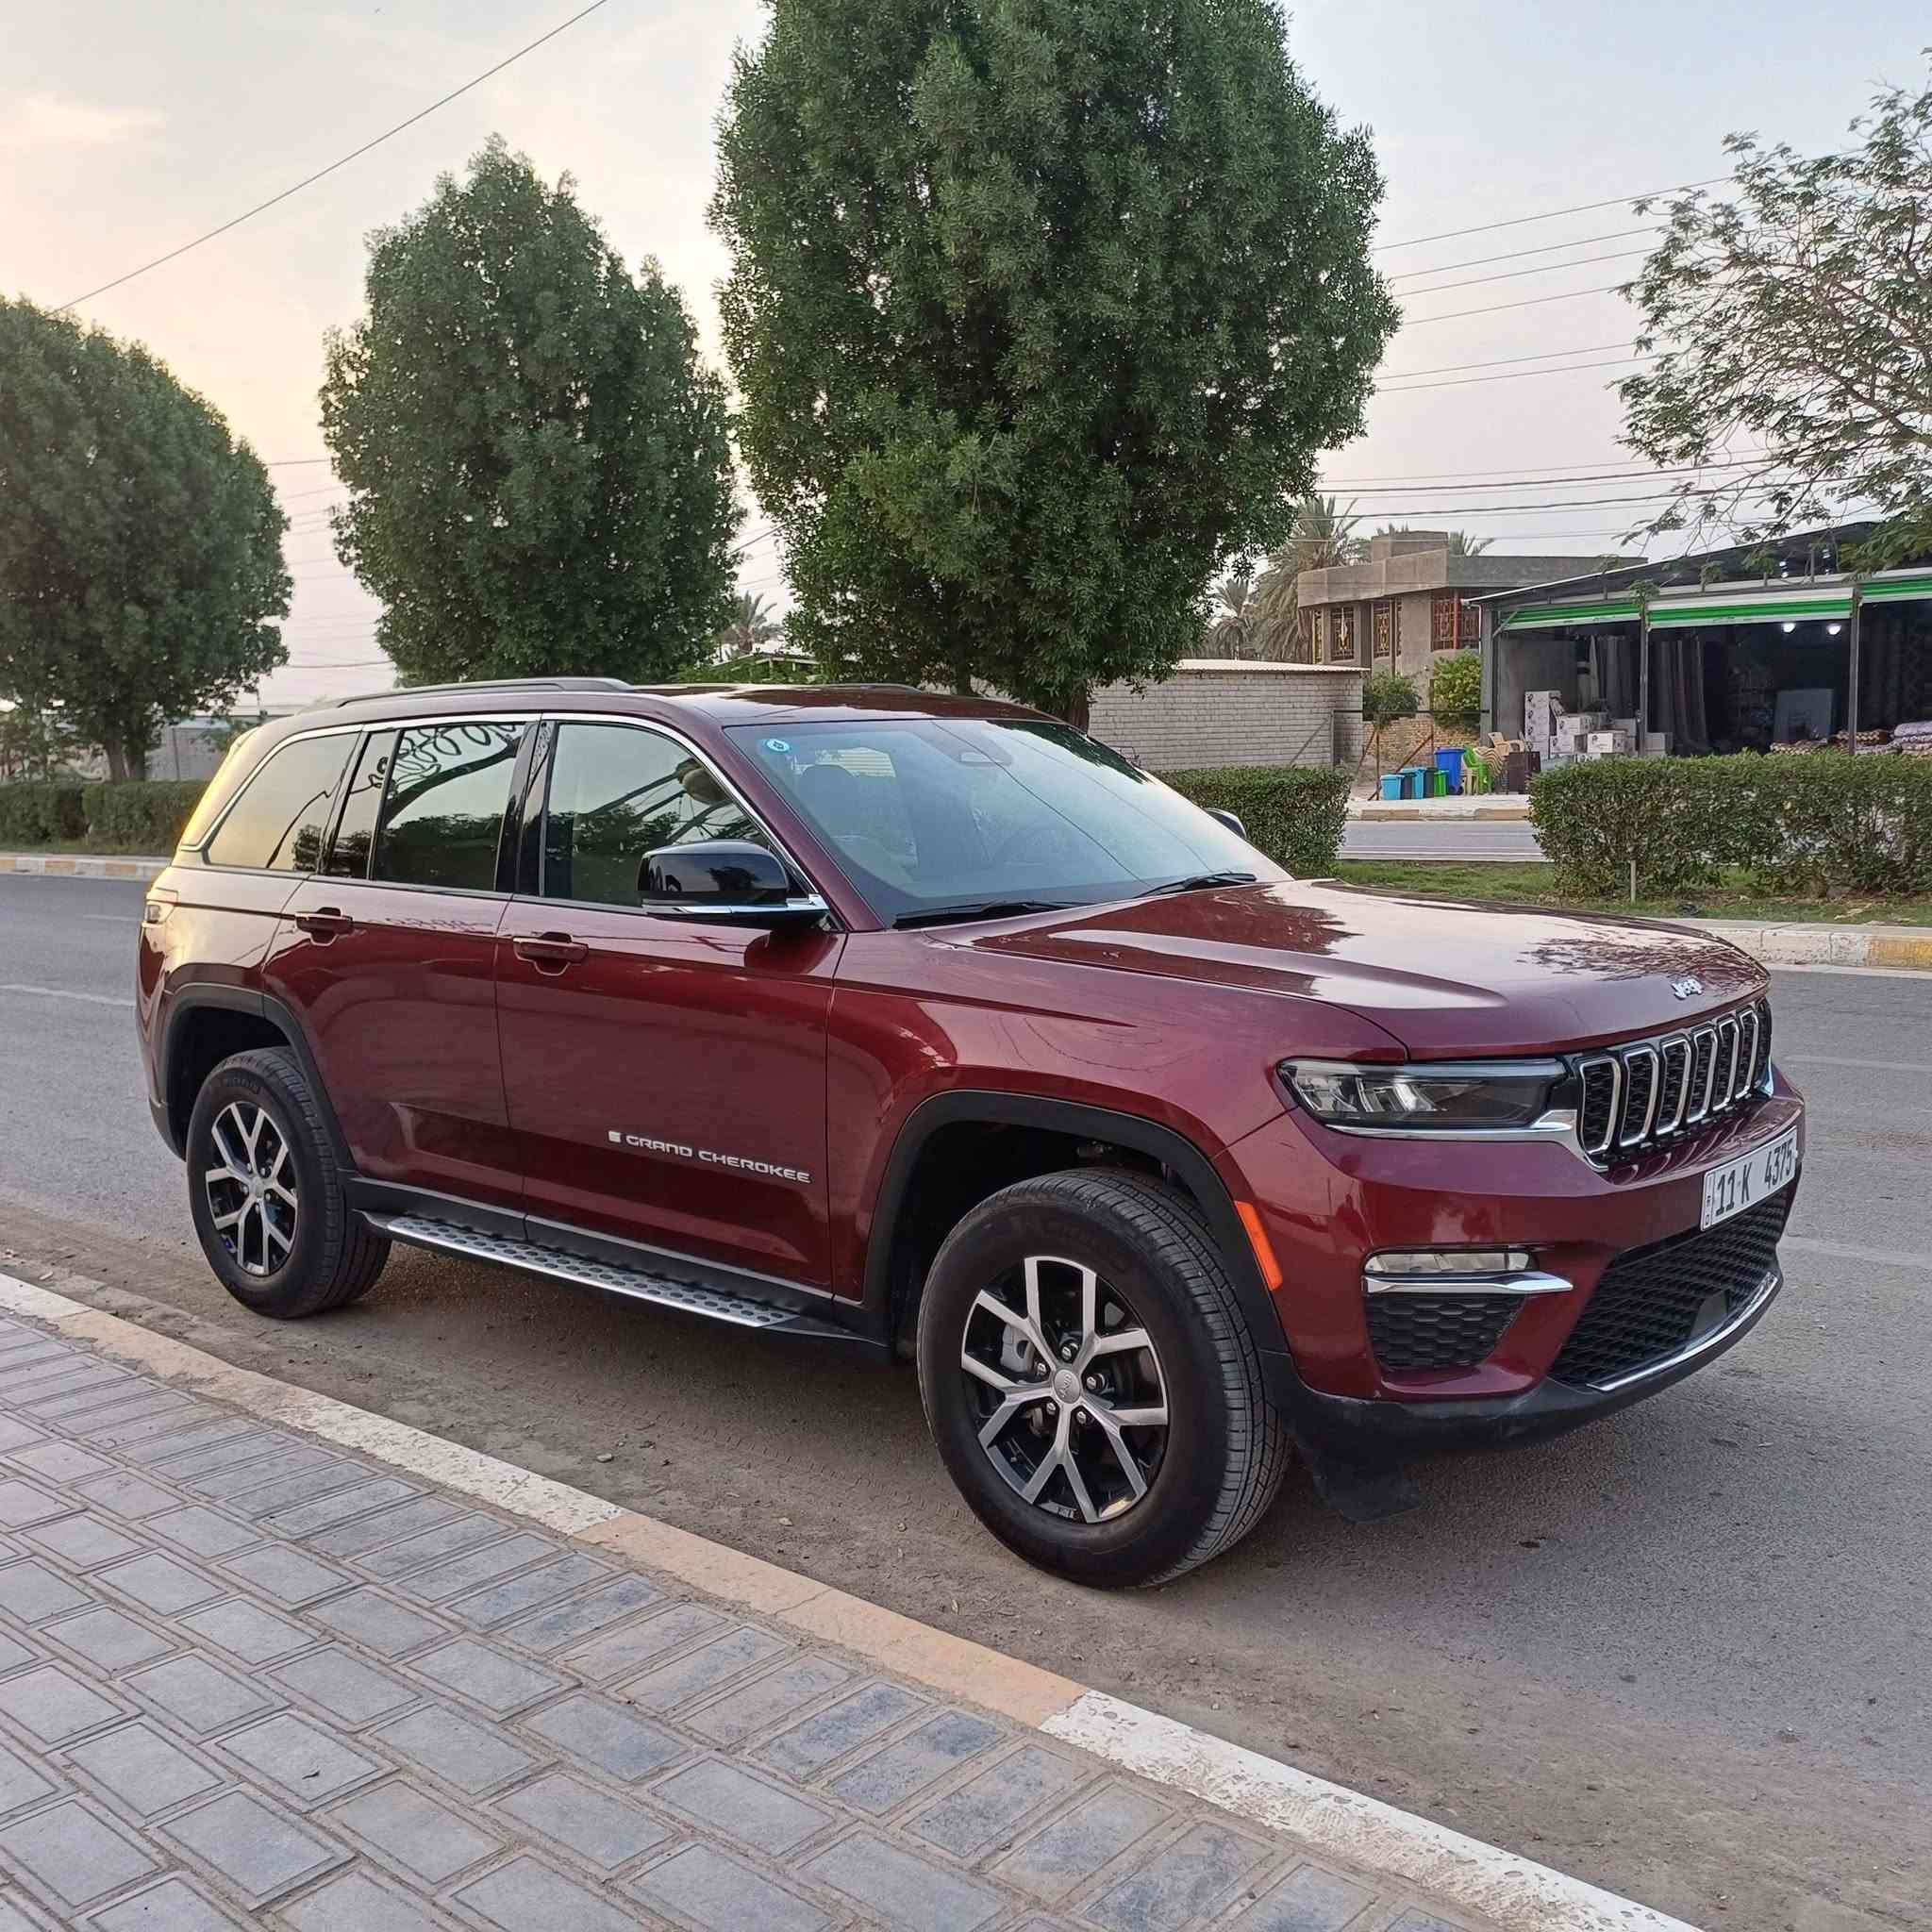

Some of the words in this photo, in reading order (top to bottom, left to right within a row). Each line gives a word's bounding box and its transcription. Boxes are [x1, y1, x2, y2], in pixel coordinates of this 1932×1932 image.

[625, 1135, 693, 1158] GRAND
[698, 1150, 811, 1184] CHEROKEE
[1715, 1169, 1736, 1217] 11
[1740, 1161, 1753, 1205] K
[1764, 1138, 1793, 1190] 4375
